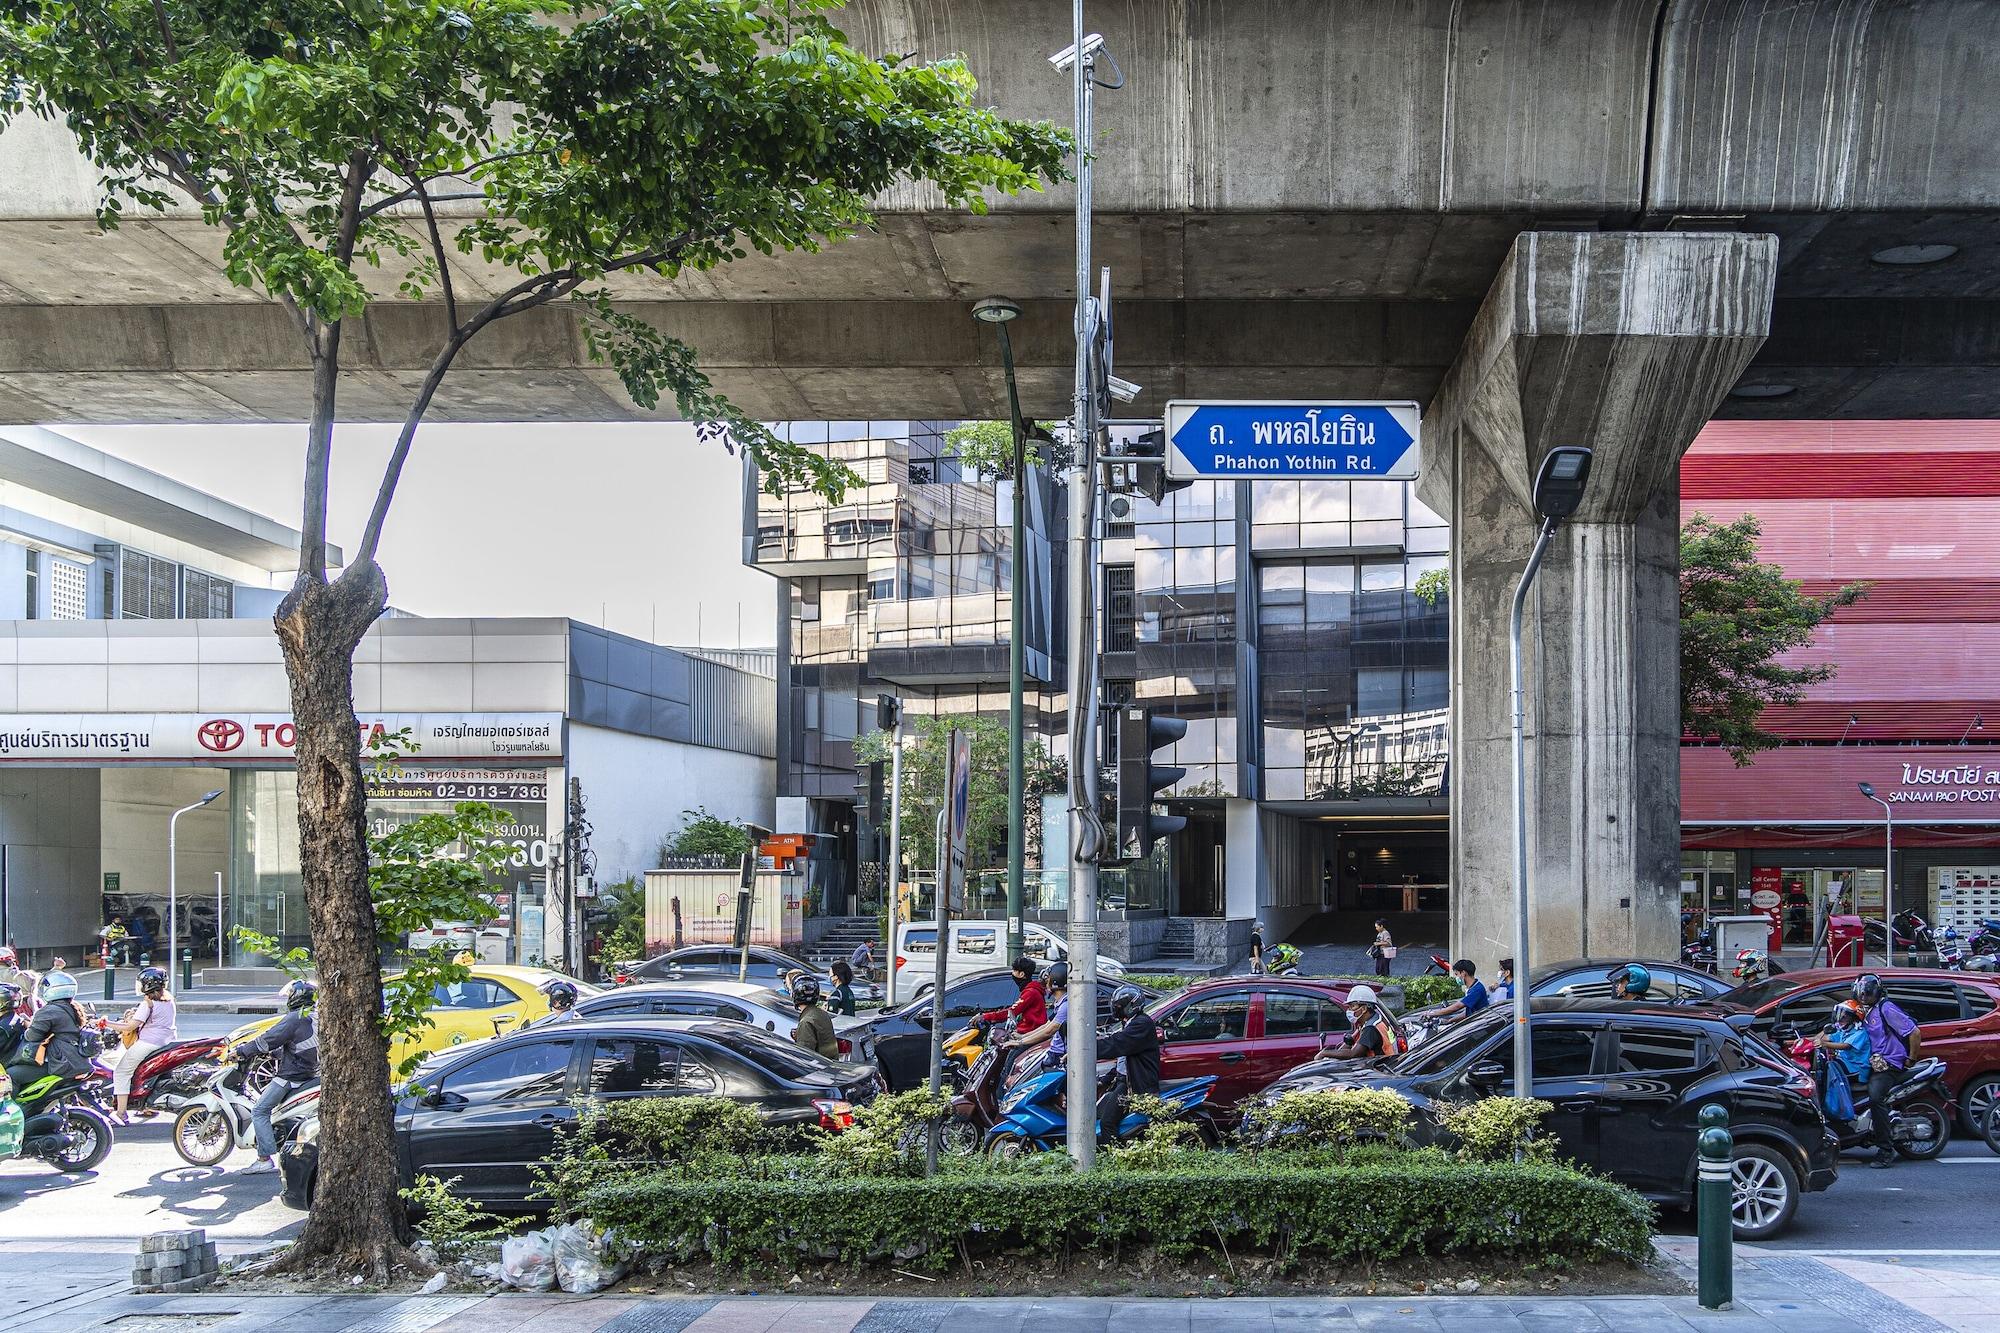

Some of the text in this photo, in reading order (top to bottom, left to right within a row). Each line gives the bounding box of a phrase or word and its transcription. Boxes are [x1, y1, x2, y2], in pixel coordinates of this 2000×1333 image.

[1209, 409, 1376, 445] ถ. พหลโยธิน
[1215, 455, 1377, 470] Phahon Yothin Rd.
[433, 723, 550, 739] เจริญไทยมอเตอร์เซลส์
[0, 727, 150, 753] ศูนย์บริการมาตรฐาน
[492, 741, 550, 754] โชว์รูมพหลโยธิน
[1901, 763, 1982, 784] ไปรษณีย์
[437, 785, 547, 798] 02-013-7360
[1888, 791, 1933, 802] SANAM
[1935, 791, 1958, 802] PAO
[1961, 789, 1997, 802] POST
